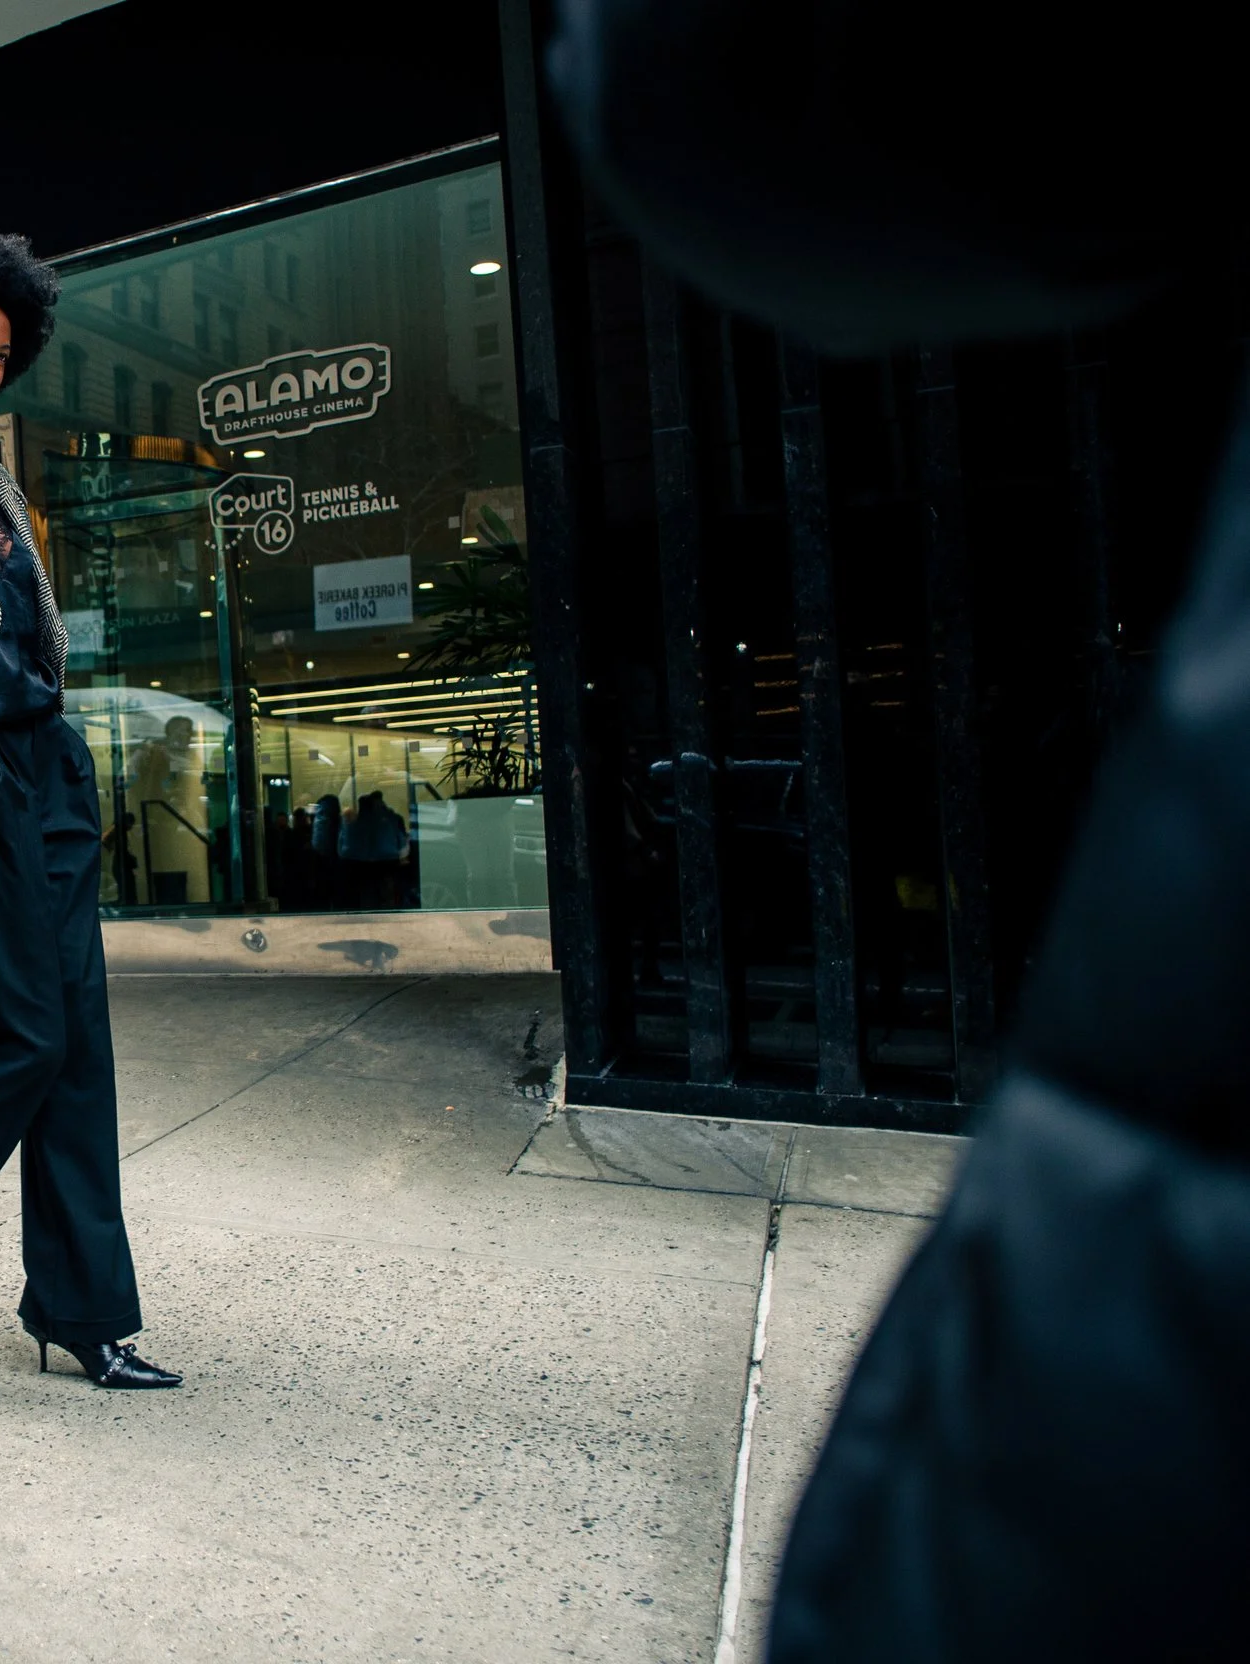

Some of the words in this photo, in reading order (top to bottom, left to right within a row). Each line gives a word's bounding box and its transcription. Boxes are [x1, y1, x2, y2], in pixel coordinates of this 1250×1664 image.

[215, 356, 375, 418] ALAMO
[224, 407, 309, 433] DRAFTHOUSE
[313, 396, 364, 416] CINEMA
[215, 483, 288, 517] Court
[301, 484, 360, 507] TENNIS
[364, 481, 378, 498] &
[302, 496, 399, 524] PICKLEBALL
[260, 519, 288, 544] 16
